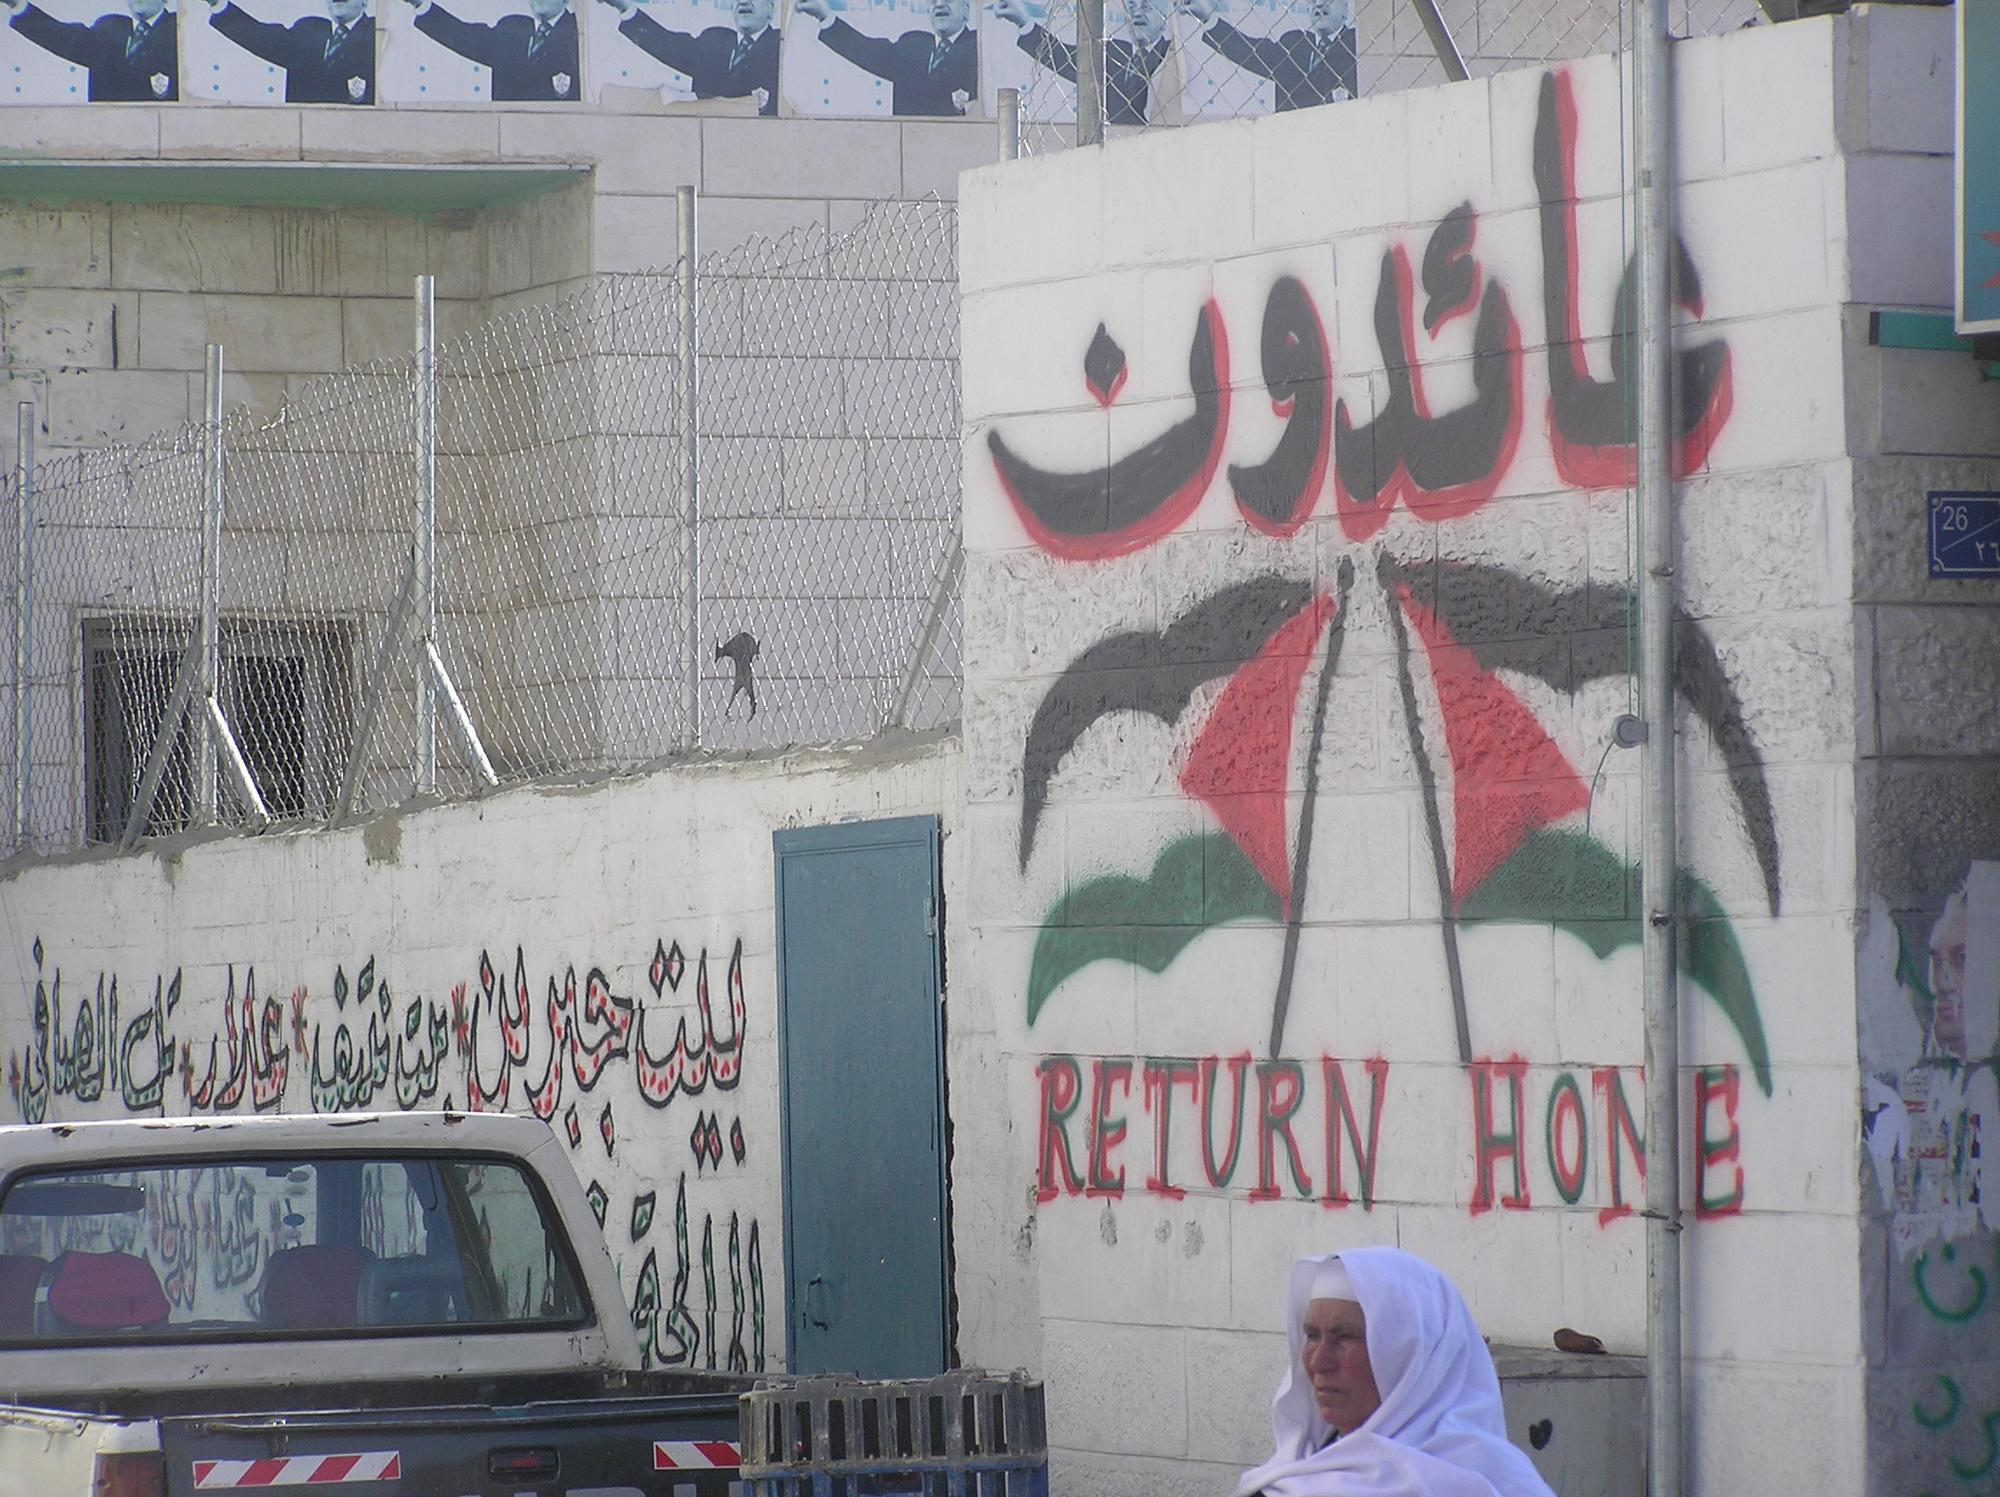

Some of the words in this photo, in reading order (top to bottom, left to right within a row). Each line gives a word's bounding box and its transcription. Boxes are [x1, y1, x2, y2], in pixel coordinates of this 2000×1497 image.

[988, 66, 1733, 562] عائدون
[1943, 506, 1968, 530] 26
[1036, 1052, 1389, 1212] RETURN
